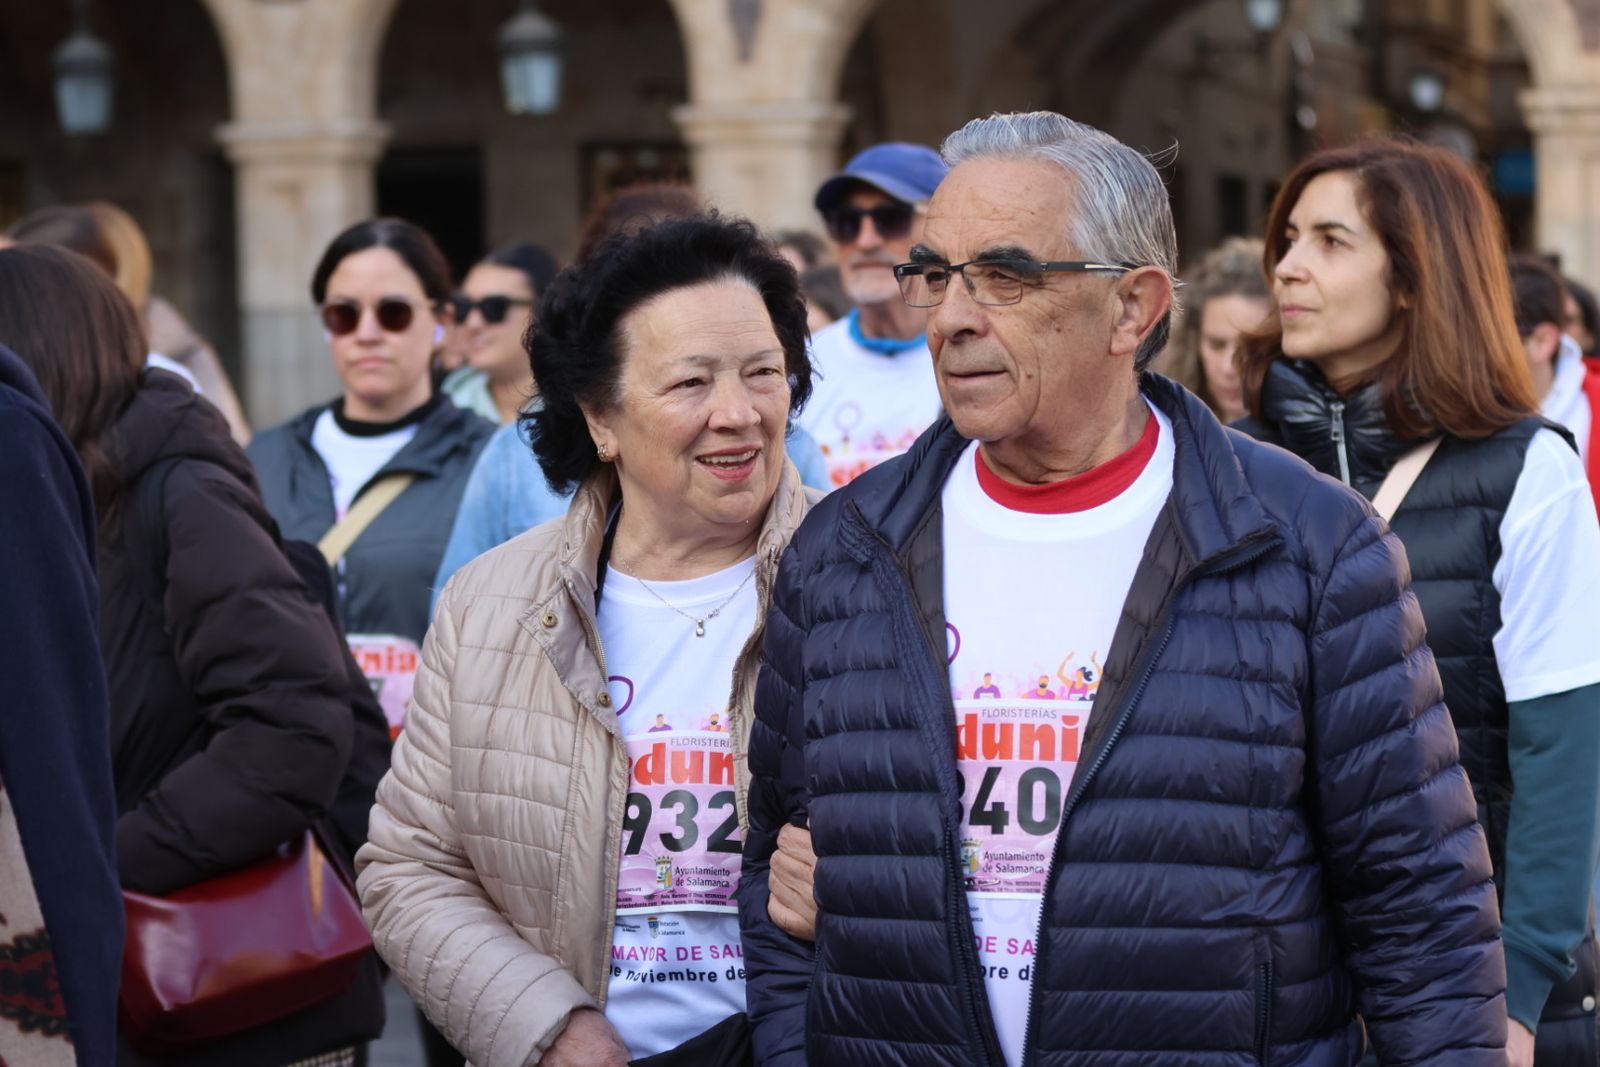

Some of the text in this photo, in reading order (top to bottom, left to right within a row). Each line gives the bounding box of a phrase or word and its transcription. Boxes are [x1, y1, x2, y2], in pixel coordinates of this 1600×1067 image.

[352, 645, 416, 673] nia
[982, 708, 1057, 719] FLORISTERÍAS
[670, 737, 734, 748] FLORISTERÍ
[622, 789, 743, 856] 932
[984, 851, 1045, 863] Ayuntamiento
[675, 866, 730, 877] Ayuntamiento
[982, 863, 1045, 874] de Salamanca
[675, 876, 730, 888] de Salamanca
[612, 946, 668, 962] MAYOR
[676, 946, 703, 961] DE
[625, 968, 718, 983] noviembre
[725, 966, 746, 980] de
